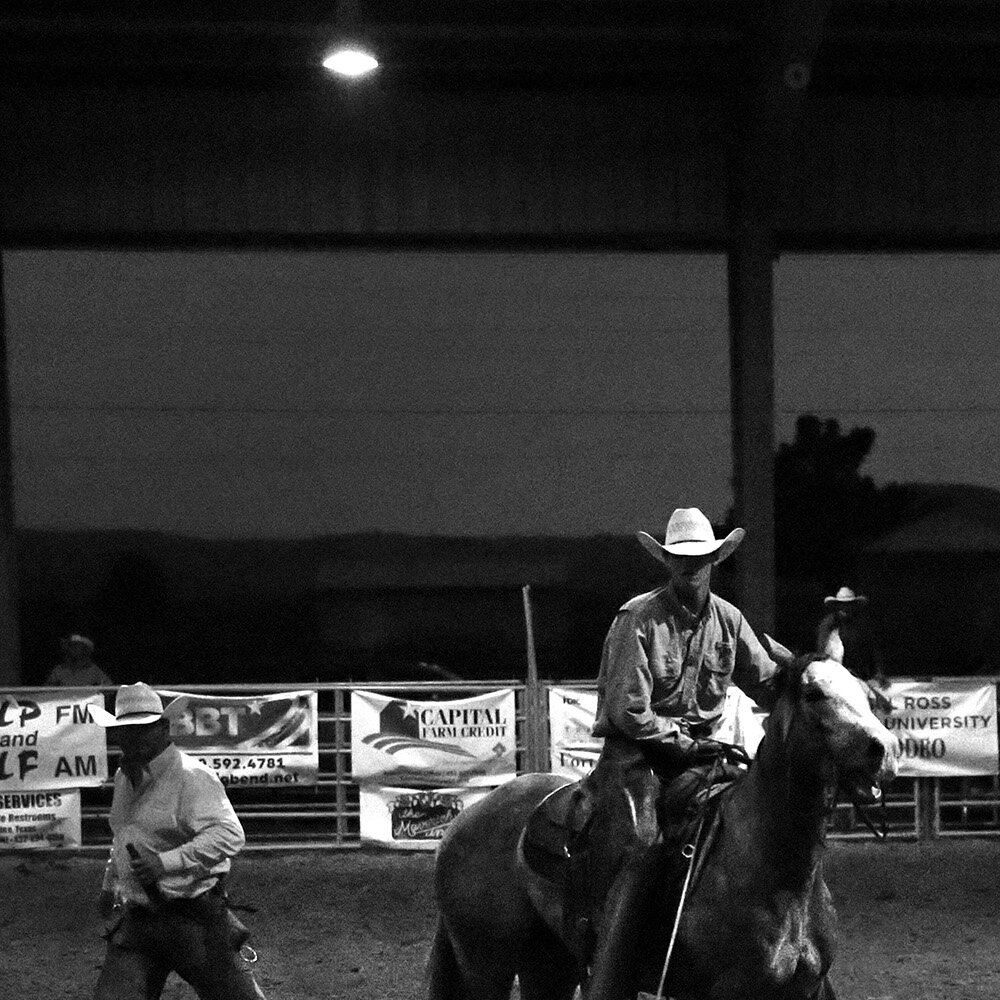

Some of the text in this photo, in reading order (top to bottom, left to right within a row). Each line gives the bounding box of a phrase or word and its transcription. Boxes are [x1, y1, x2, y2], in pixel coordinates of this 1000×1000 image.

[904, 696, 952, 710] ROSS
[56, 704, 94, 724] FM
[169, 706, 246, 736] BBT
[420, 708, 506, 726] CAPITAL
[884, 715, 991, 730] UNIVERSITY
[0, 730, 38, 747] and
[422, 726, 507, 738] FARM CREDIT
[54, 755, 97, 778] AM
